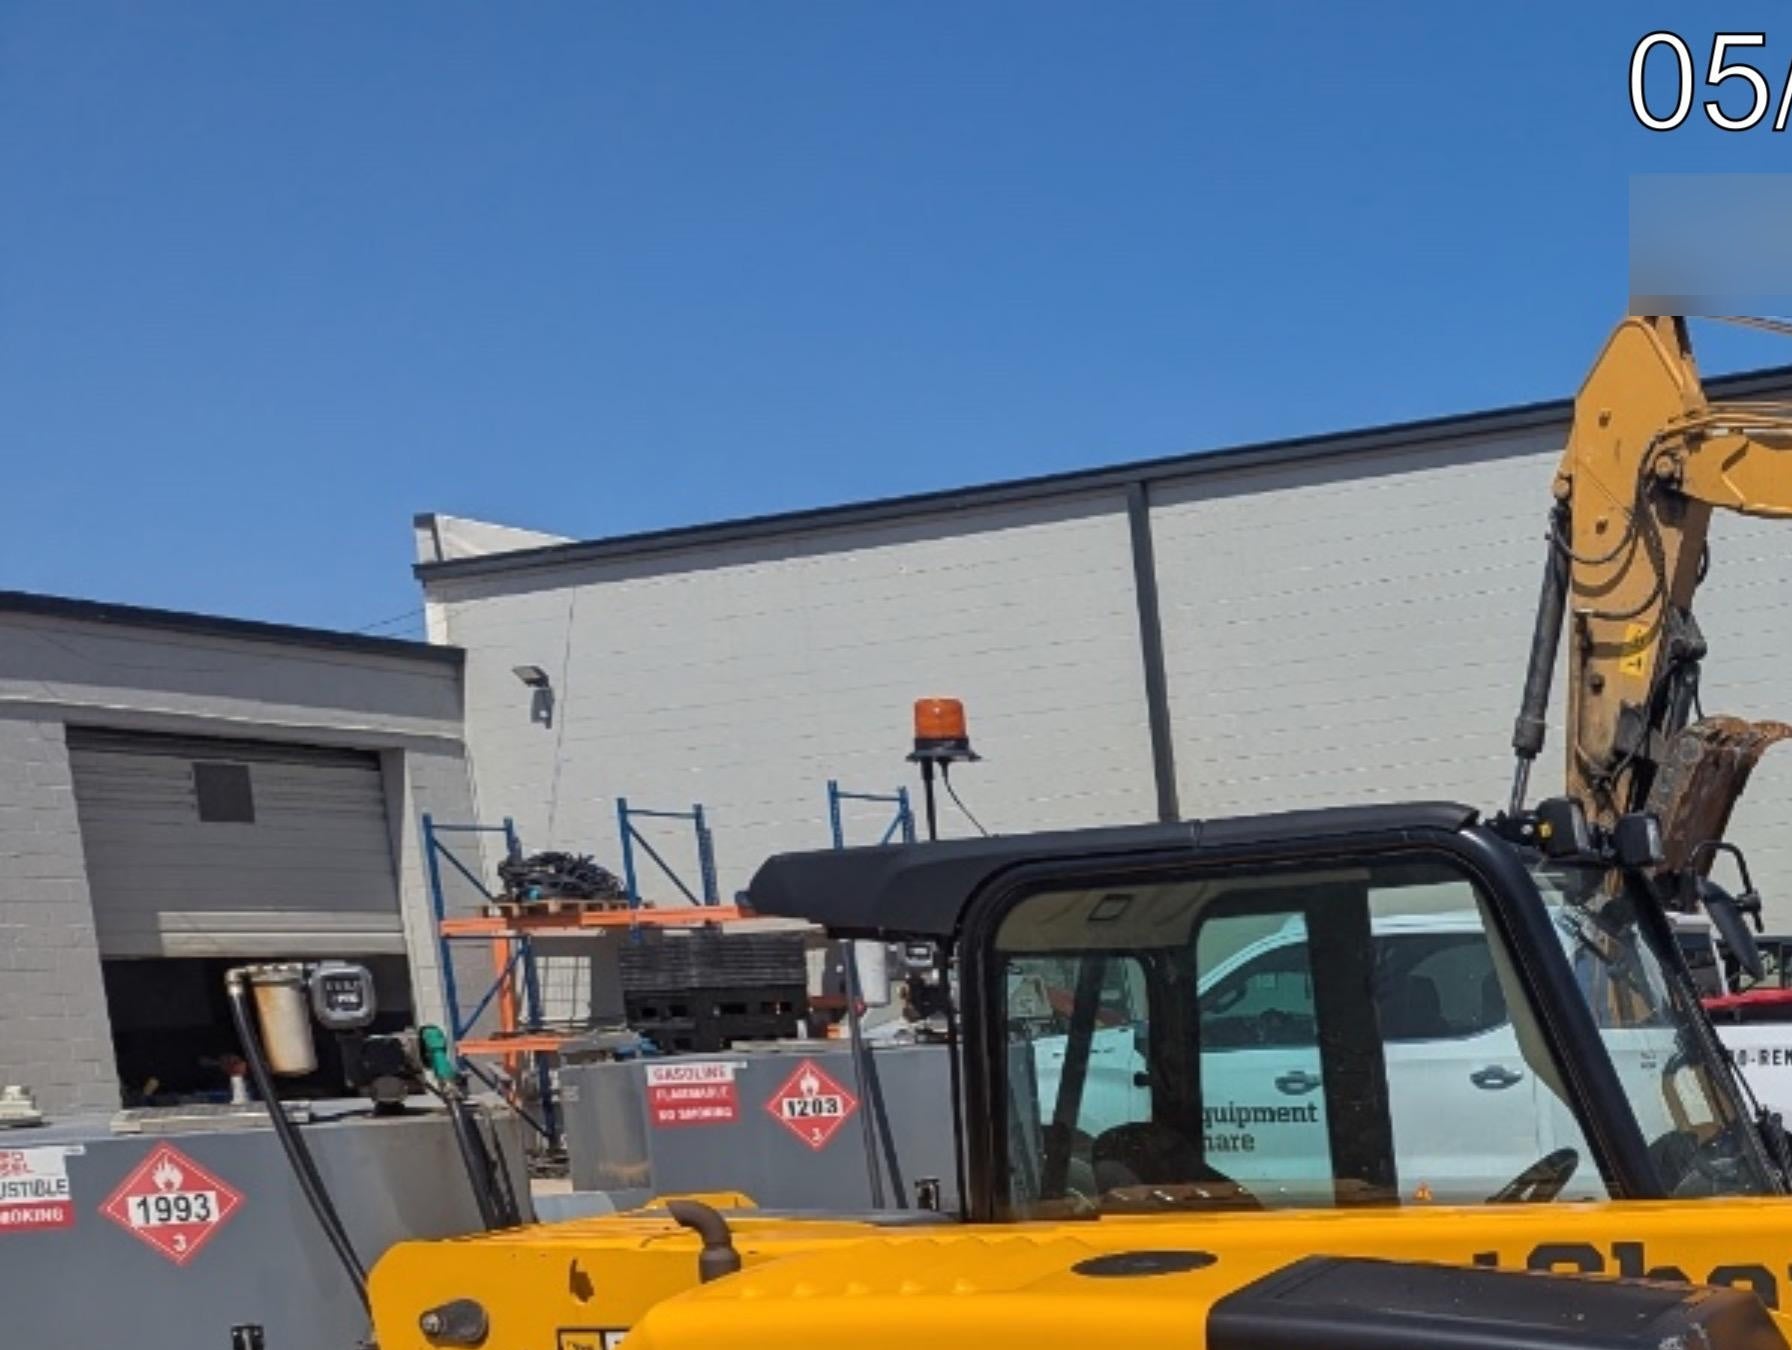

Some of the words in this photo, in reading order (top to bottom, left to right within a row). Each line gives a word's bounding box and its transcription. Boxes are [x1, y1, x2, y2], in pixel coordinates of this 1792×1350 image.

[788, 1097, 838, 1117] 1203
[1203, 1100, 1318, 1129] quipment
[1203, 1133, 1255, 1153] hare
[136, 1192, 211, 1225] 1993
[173, 1233, 187, 1252] 3
